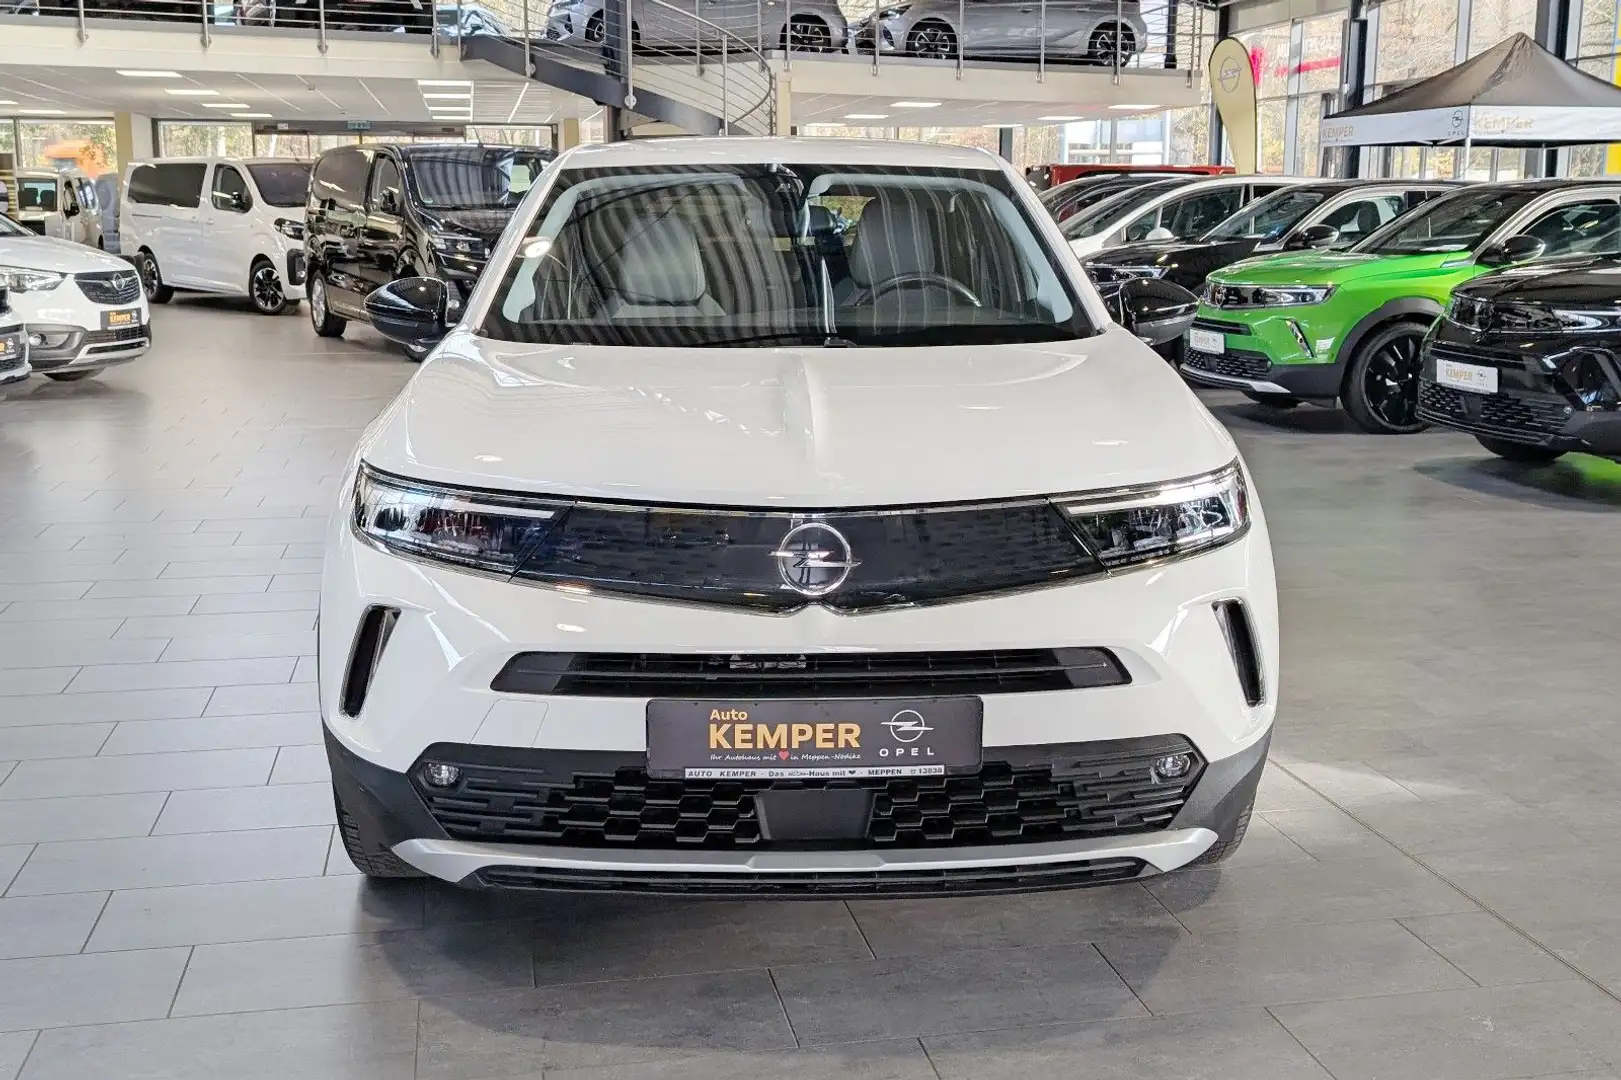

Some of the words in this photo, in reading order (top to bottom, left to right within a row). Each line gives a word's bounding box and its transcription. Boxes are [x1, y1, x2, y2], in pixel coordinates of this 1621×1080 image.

[1321, 126, 1354, 138] KEMPER
[1446, 367, 1473, 380] KEMPER
[710, 709, 748, 721] Auto
[709, 723, 861, 749] KEMPER
[710, 753, 722, 761] Ihr
[724, 753, 761, 761] Autohaus
[763, 753, 777, 761] mit
[790, 753, 800, 761] in
[879, 747, 935, 757] OPEL
[831, 768, 846, 777] mit
